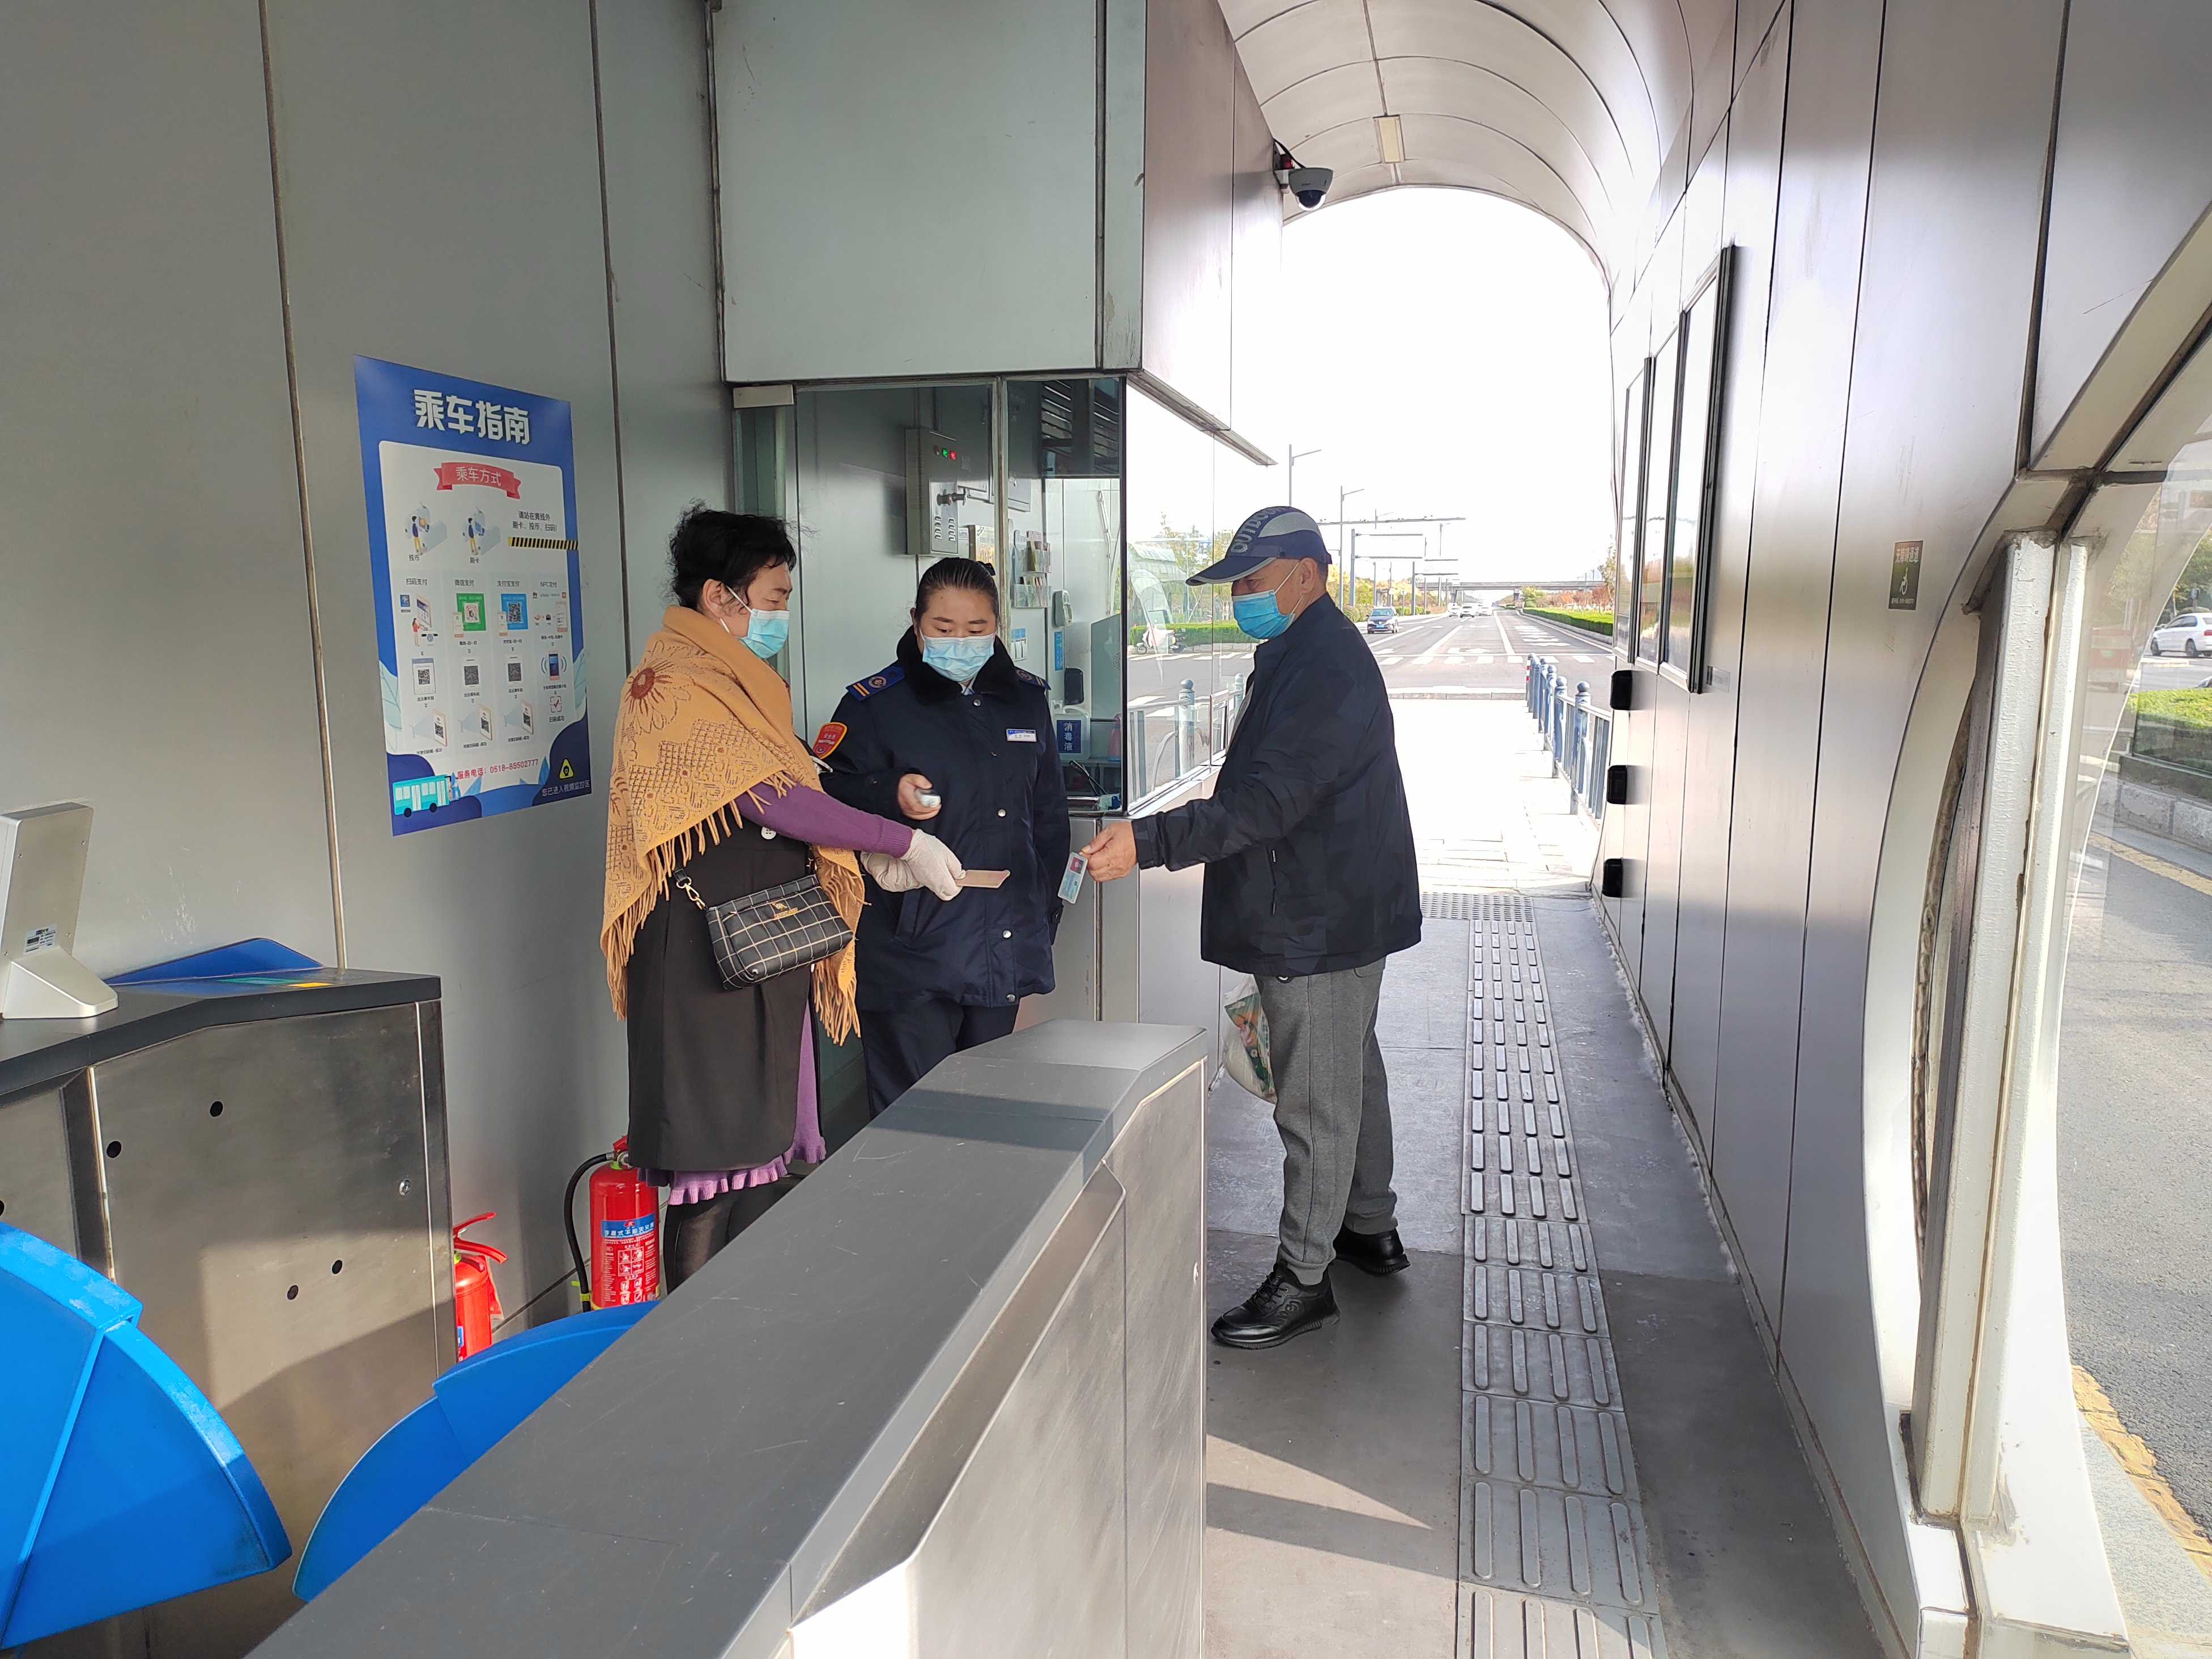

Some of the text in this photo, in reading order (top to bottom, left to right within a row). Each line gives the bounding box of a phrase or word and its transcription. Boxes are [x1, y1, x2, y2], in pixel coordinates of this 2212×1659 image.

[413, 389, 530, 445] 乘车指南
[456, 466, 502, 486] 乘车方式
[1064, 722, 1073, 751] 消毒液
